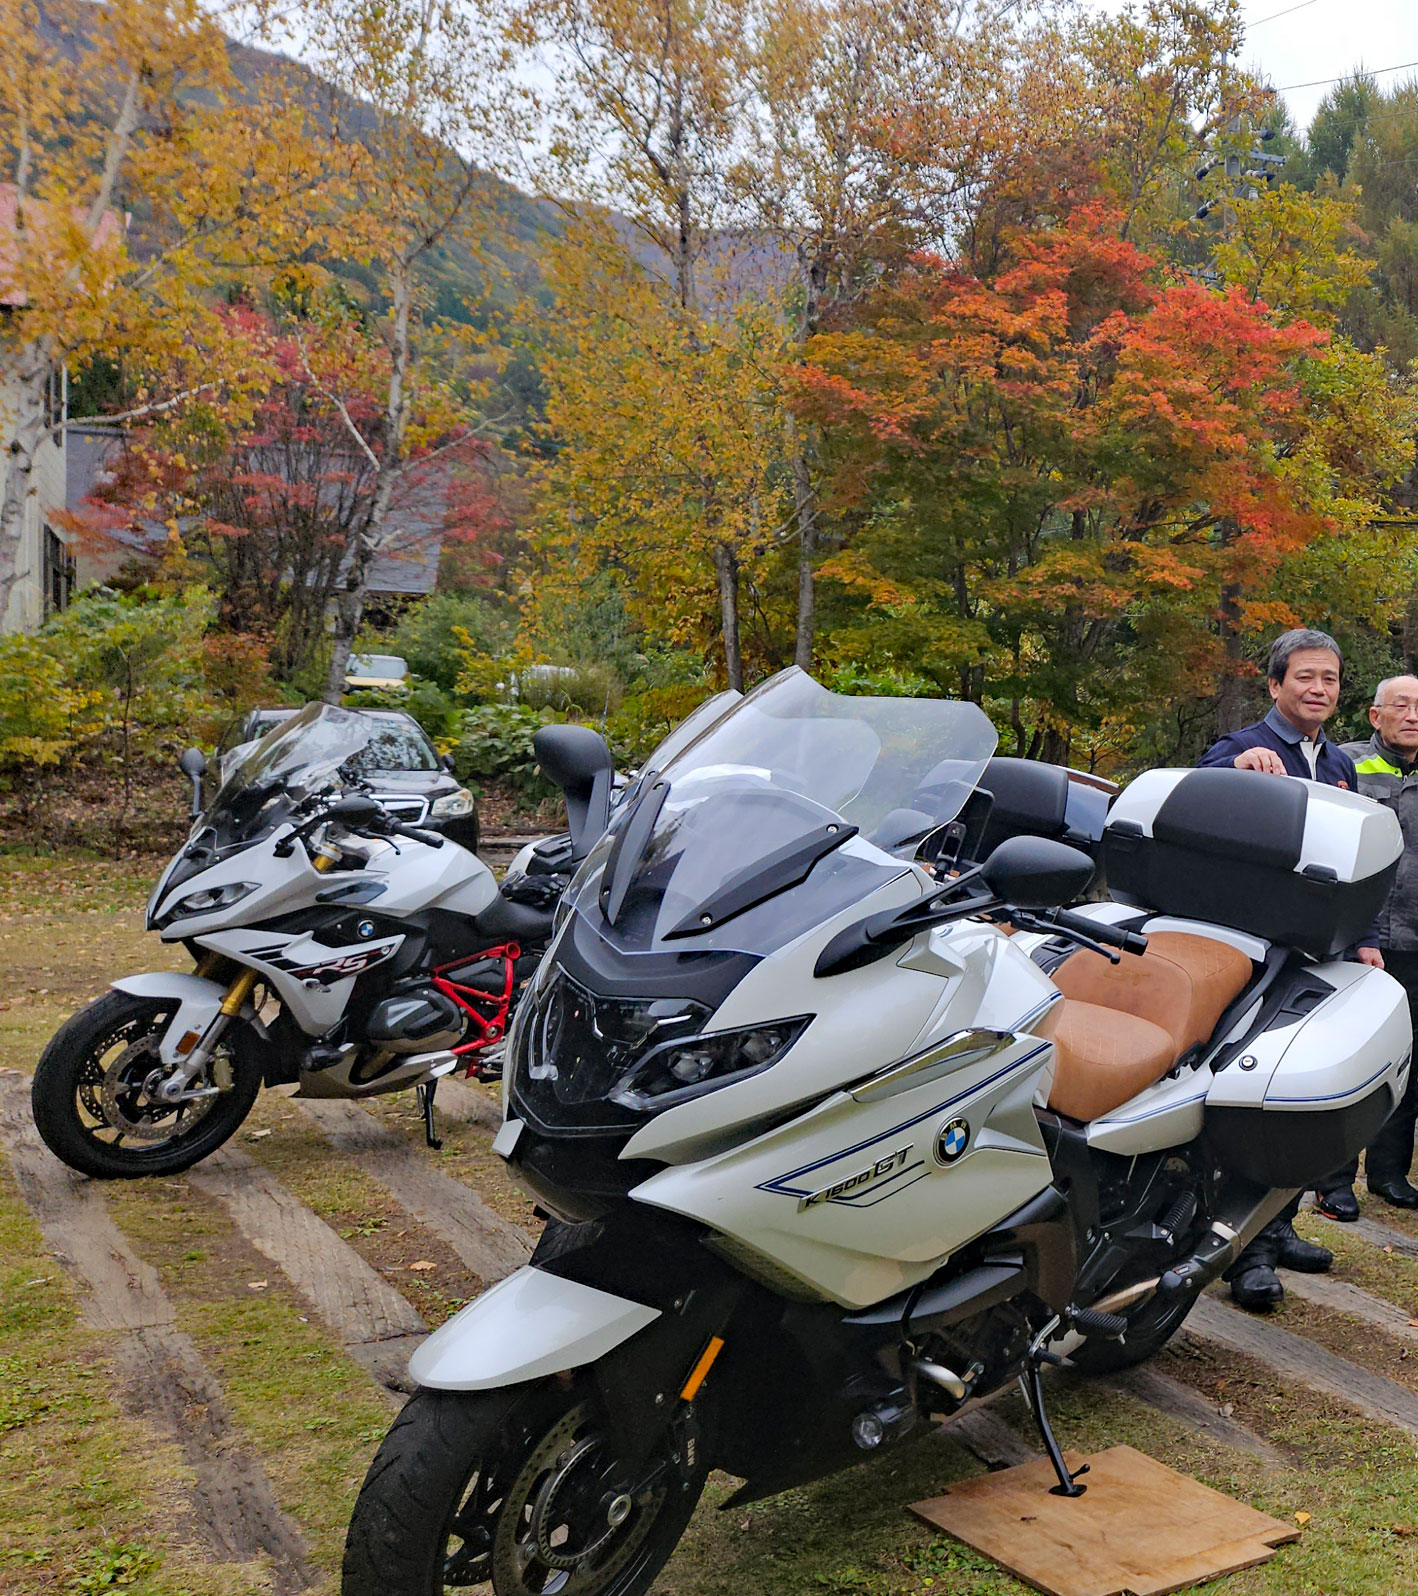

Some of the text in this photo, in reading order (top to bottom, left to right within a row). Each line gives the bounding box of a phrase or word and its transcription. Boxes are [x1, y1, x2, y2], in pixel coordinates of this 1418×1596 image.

[312, 953, 369, 975] RS
[940, 1120, 968, 1141] BMW
[873, 1142, 915, 1178] GT
